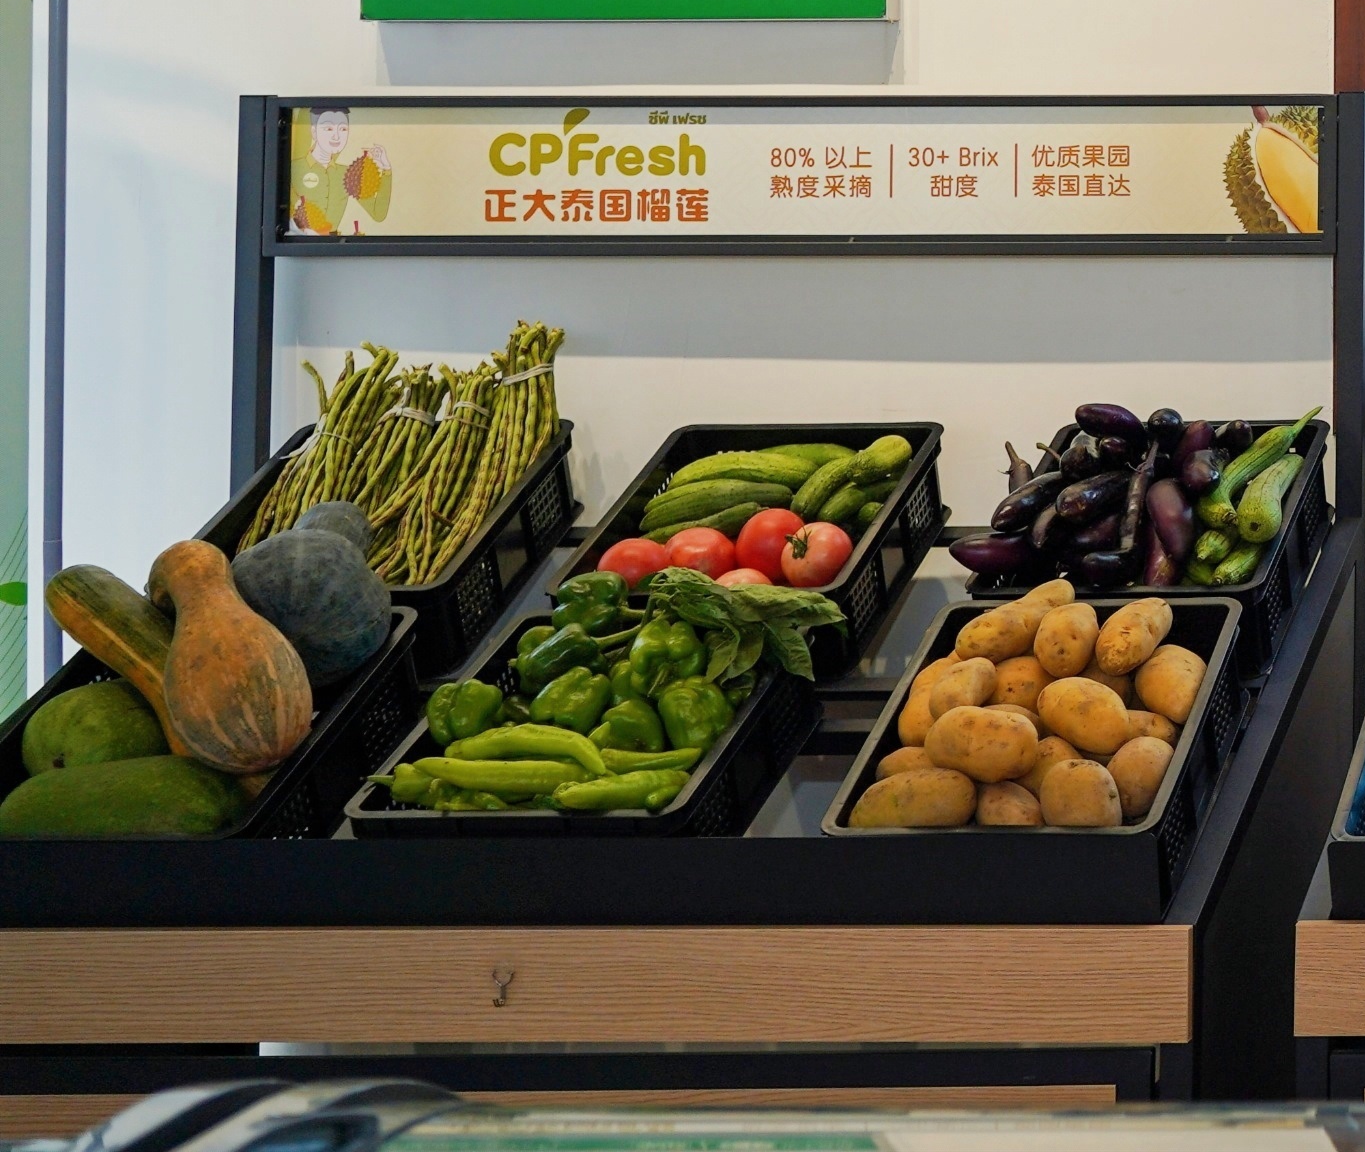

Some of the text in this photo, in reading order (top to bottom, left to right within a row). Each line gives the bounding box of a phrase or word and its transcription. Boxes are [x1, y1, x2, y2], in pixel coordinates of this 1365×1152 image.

[488, 131, 707, 177] CPFresh
[769, 146, 873, 170] 80% 以上
[908, 147, 1000, 167] 30+ Brix
[1031, 145, 1132, 170] 优质果园
[769, 174, 873, 198] 熟度采摘
[930, 174, 979, 198] 甜度
[1031, 174, 1132, 198] 泰国直达
[484, 189, 710, 223] 正大泰国榴莲
